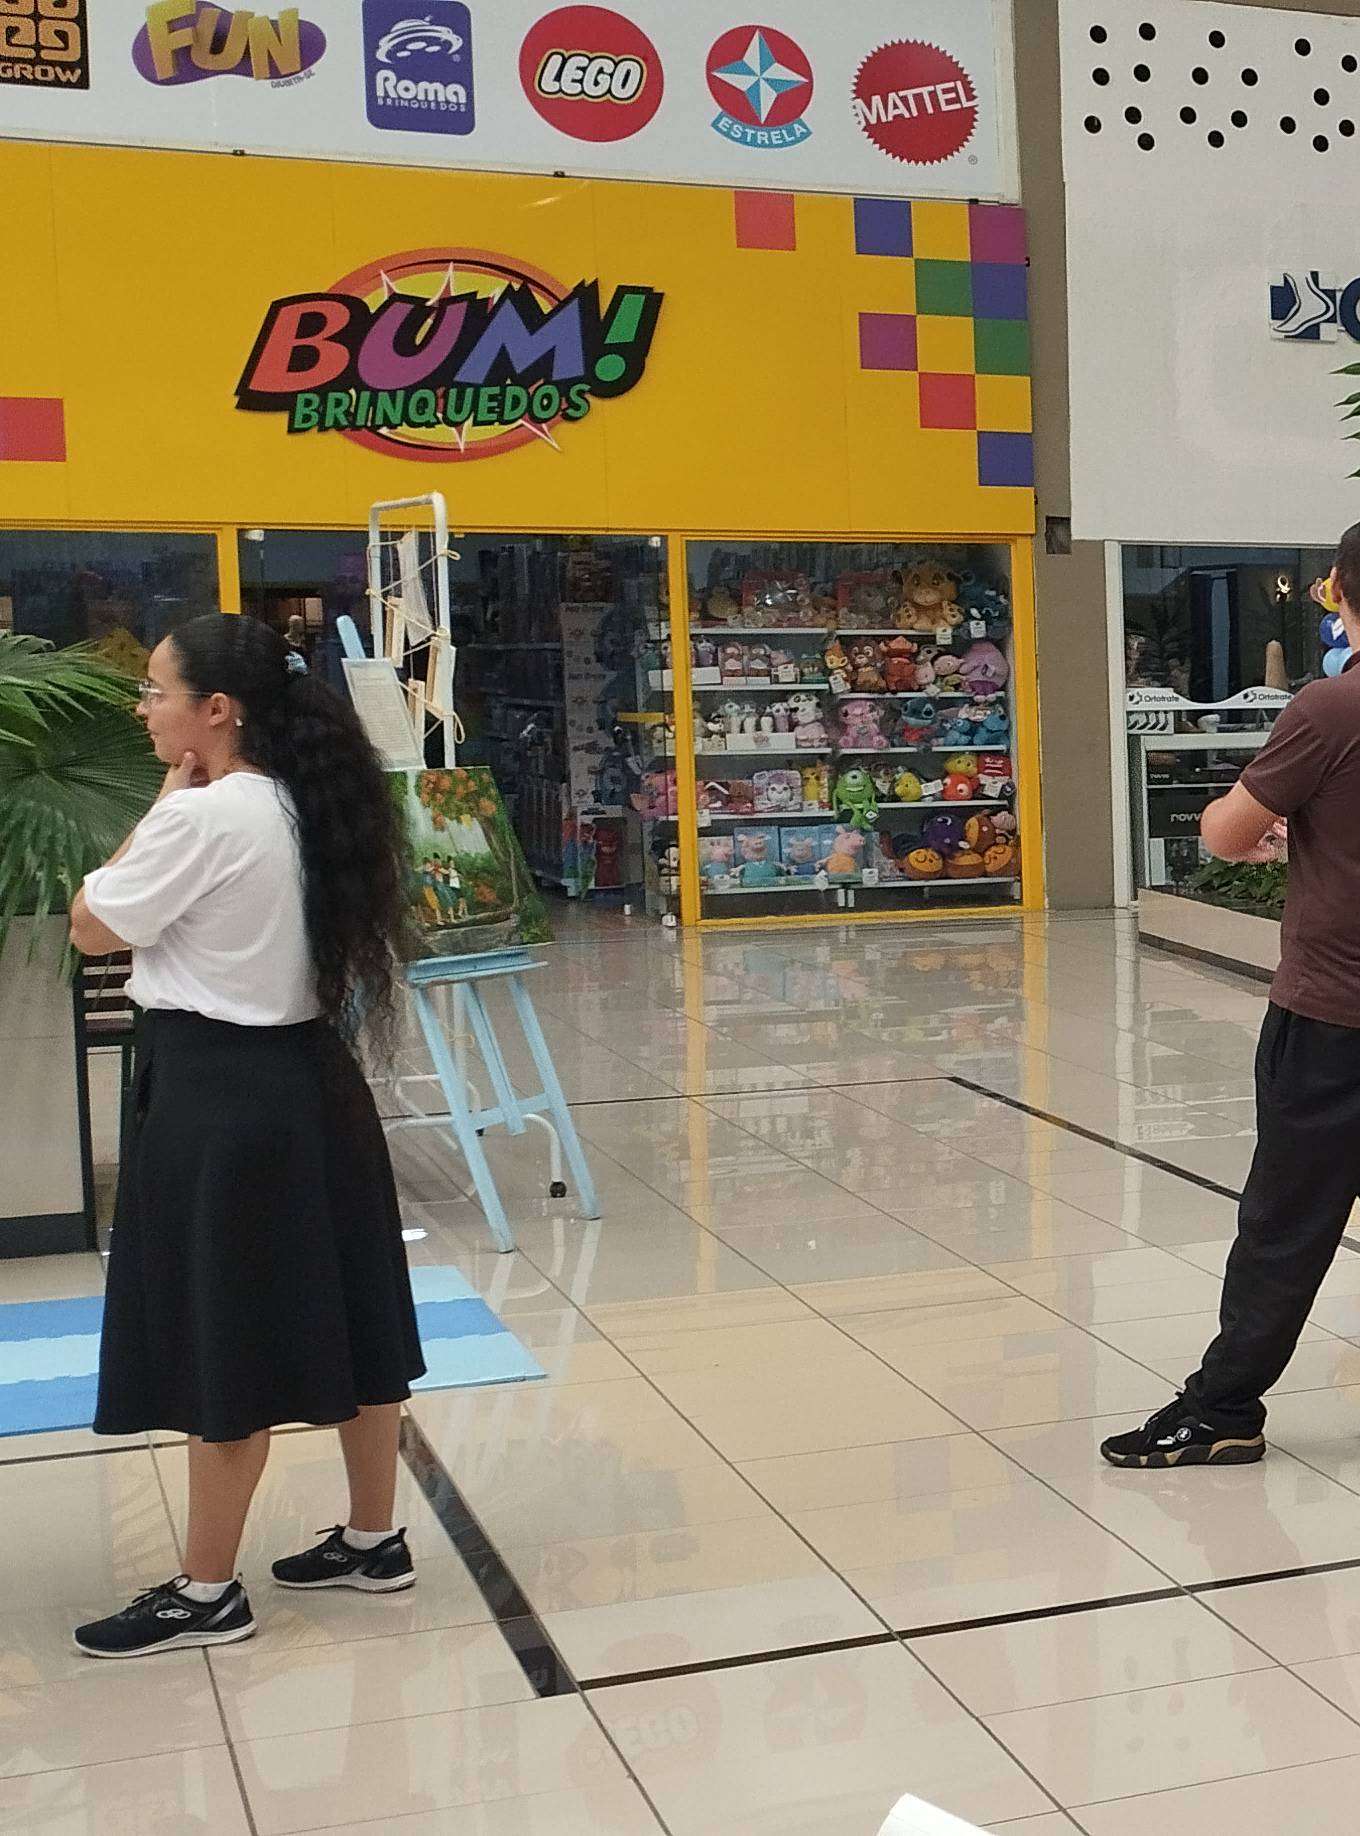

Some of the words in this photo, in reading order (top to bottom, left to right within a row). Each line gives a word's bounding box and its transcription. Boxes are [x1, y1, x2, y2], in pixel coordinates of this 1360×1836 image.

[146, 0, 301, 81] FUN
[0, 63, 82, 84] GROW
[375, 69, 467, 104] Roma
[539, 53, 643, 101] LEGO
[377, 97, 467, 112] BRINQUEDOS
[853, 80, 980, 127] MATTEL
[717, 116, 808, 145] ESTRELA
[246, 292, 649, 393] BUM!
[293, 382, 592, 431] BRINQUEDOS
